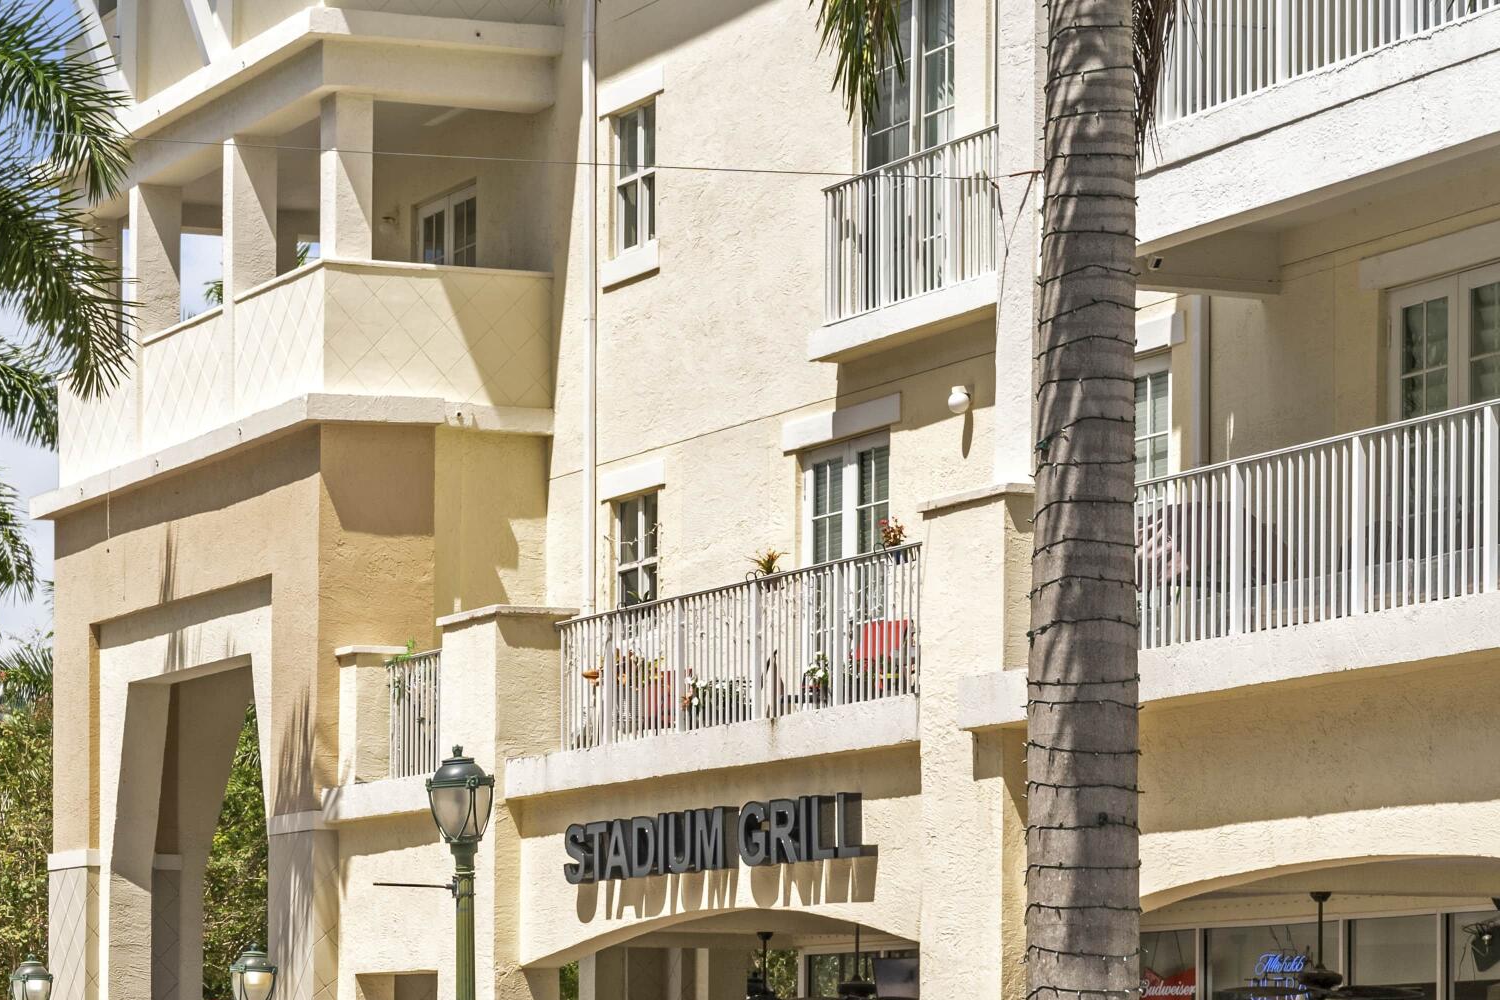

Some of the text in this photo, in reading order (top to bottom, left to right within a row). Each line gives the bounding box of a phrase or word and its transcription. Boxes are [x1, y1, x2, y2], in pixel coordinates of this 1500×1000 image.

[564, 792, 862, 884] STADIUM GRILL
[1139, 978, 1196, 998] Budweiser
